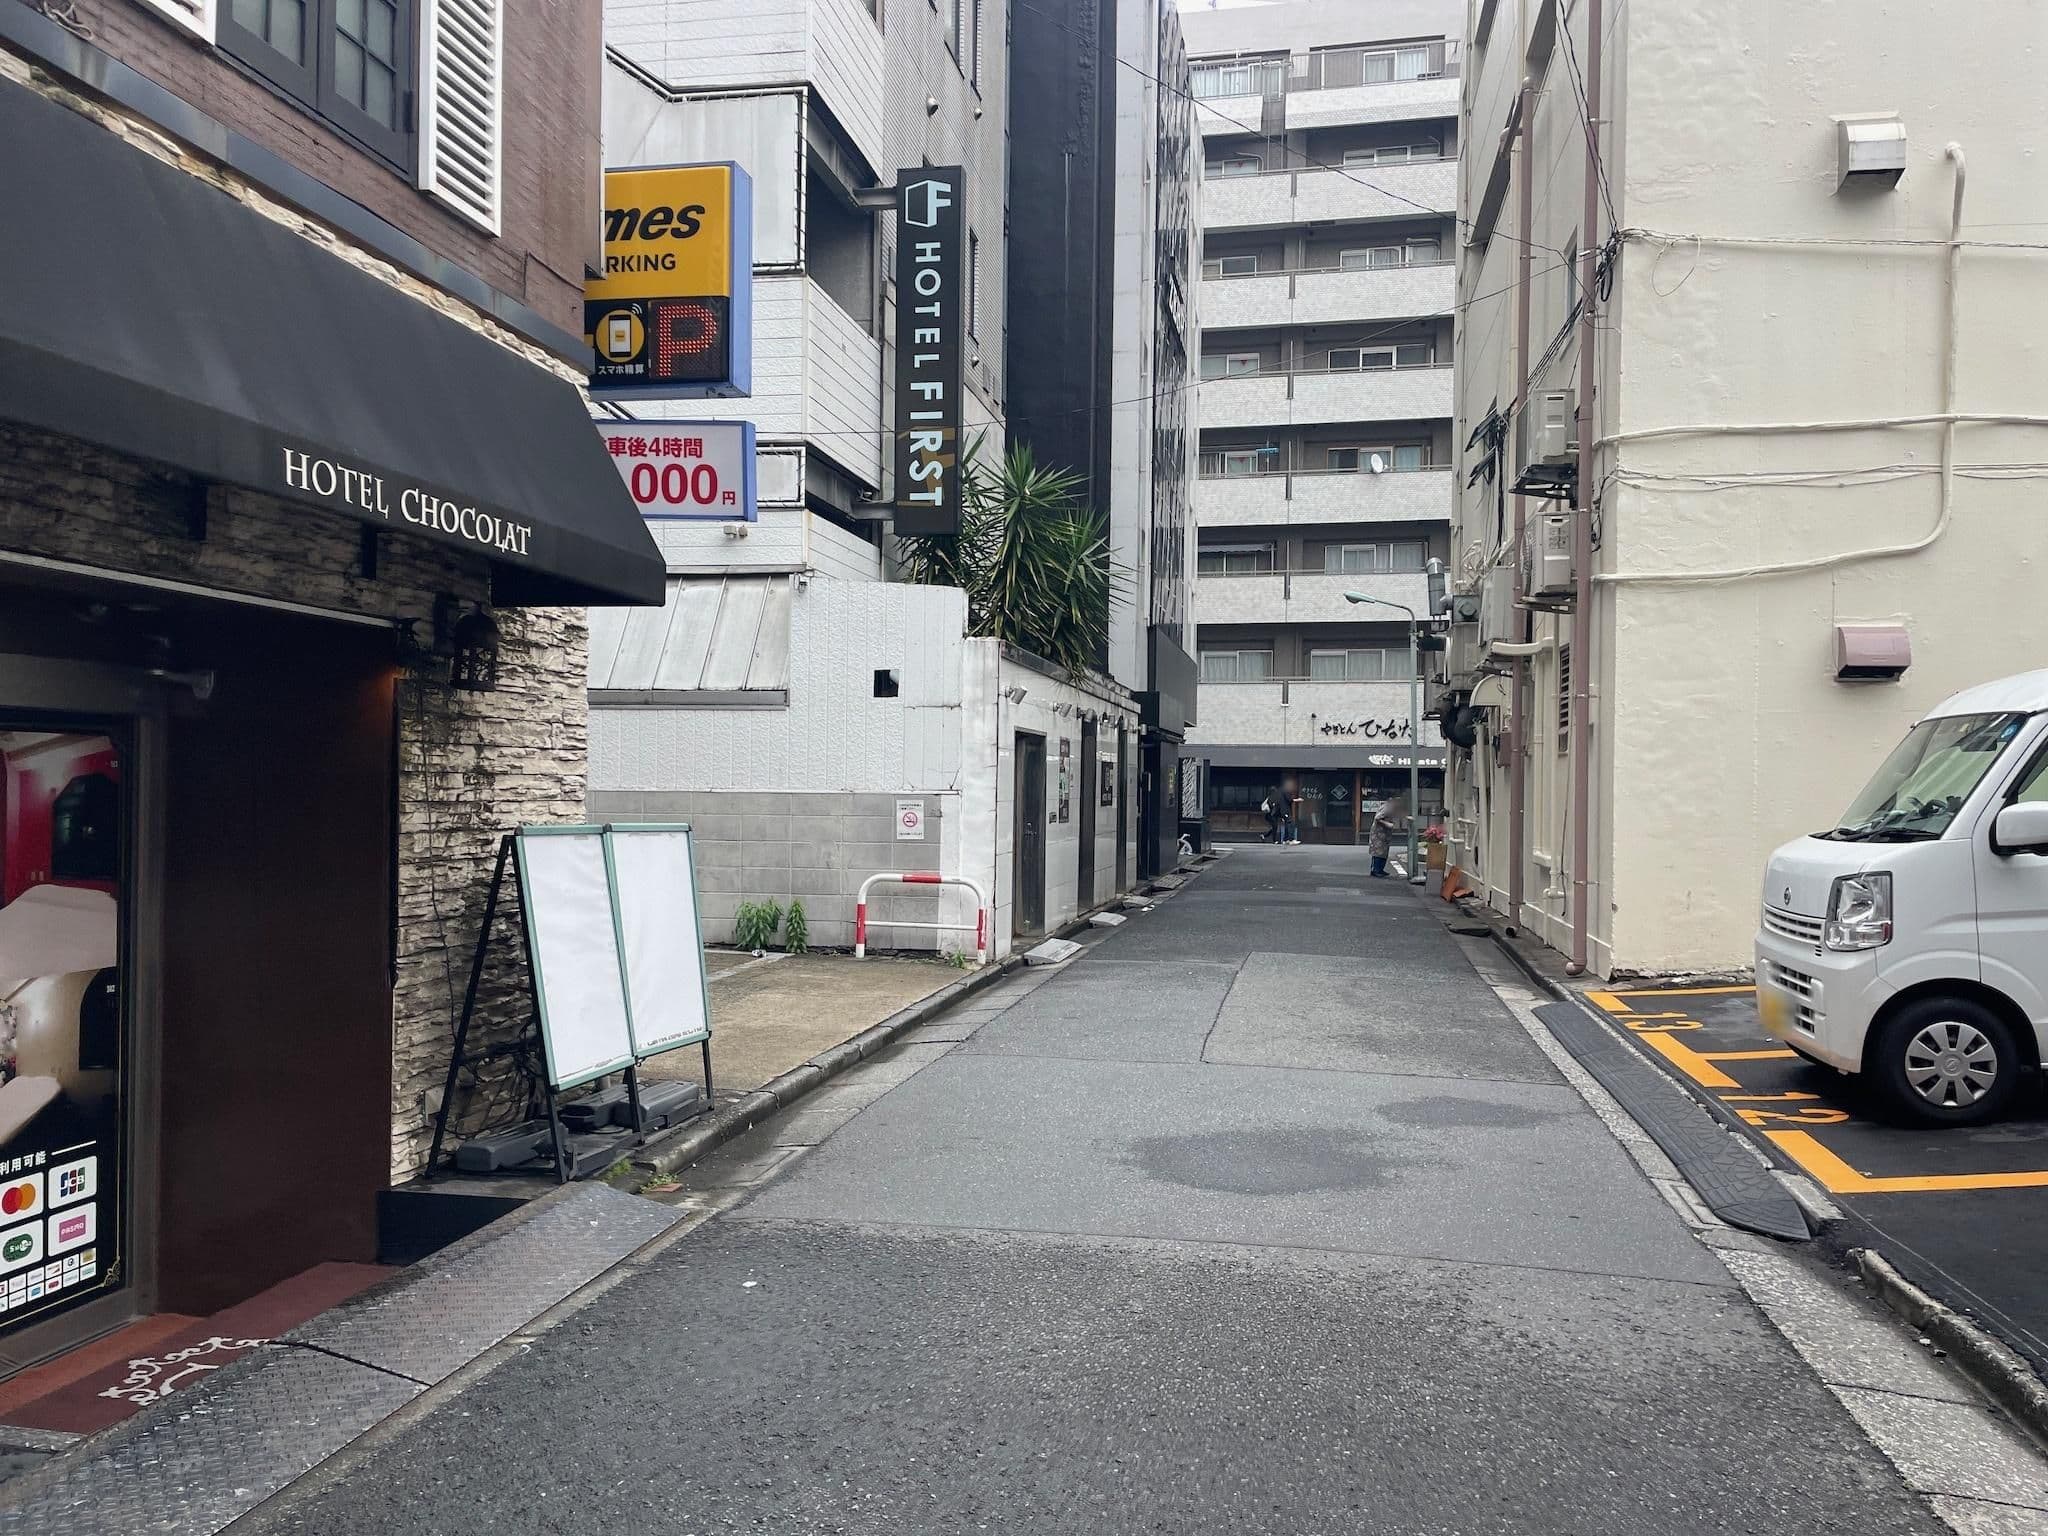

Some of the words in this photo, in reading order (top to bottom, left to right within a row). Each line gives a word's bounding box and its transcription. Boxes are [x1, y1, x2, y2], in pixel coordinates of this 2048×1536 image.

[659, 303, 718, 377] P
[914, 241, 942, 369] HOTEL
[603, 437, 703, 458] 車後4時間
[908, 381, 944, 507] FIRST
[283, 447, 390, 519] HOTEL
[400, 488, 532, 556] CHOCOLAT
[1613, 1010, 1704, 1033] 13
[1717, 1090, 1850, 1127] 12
